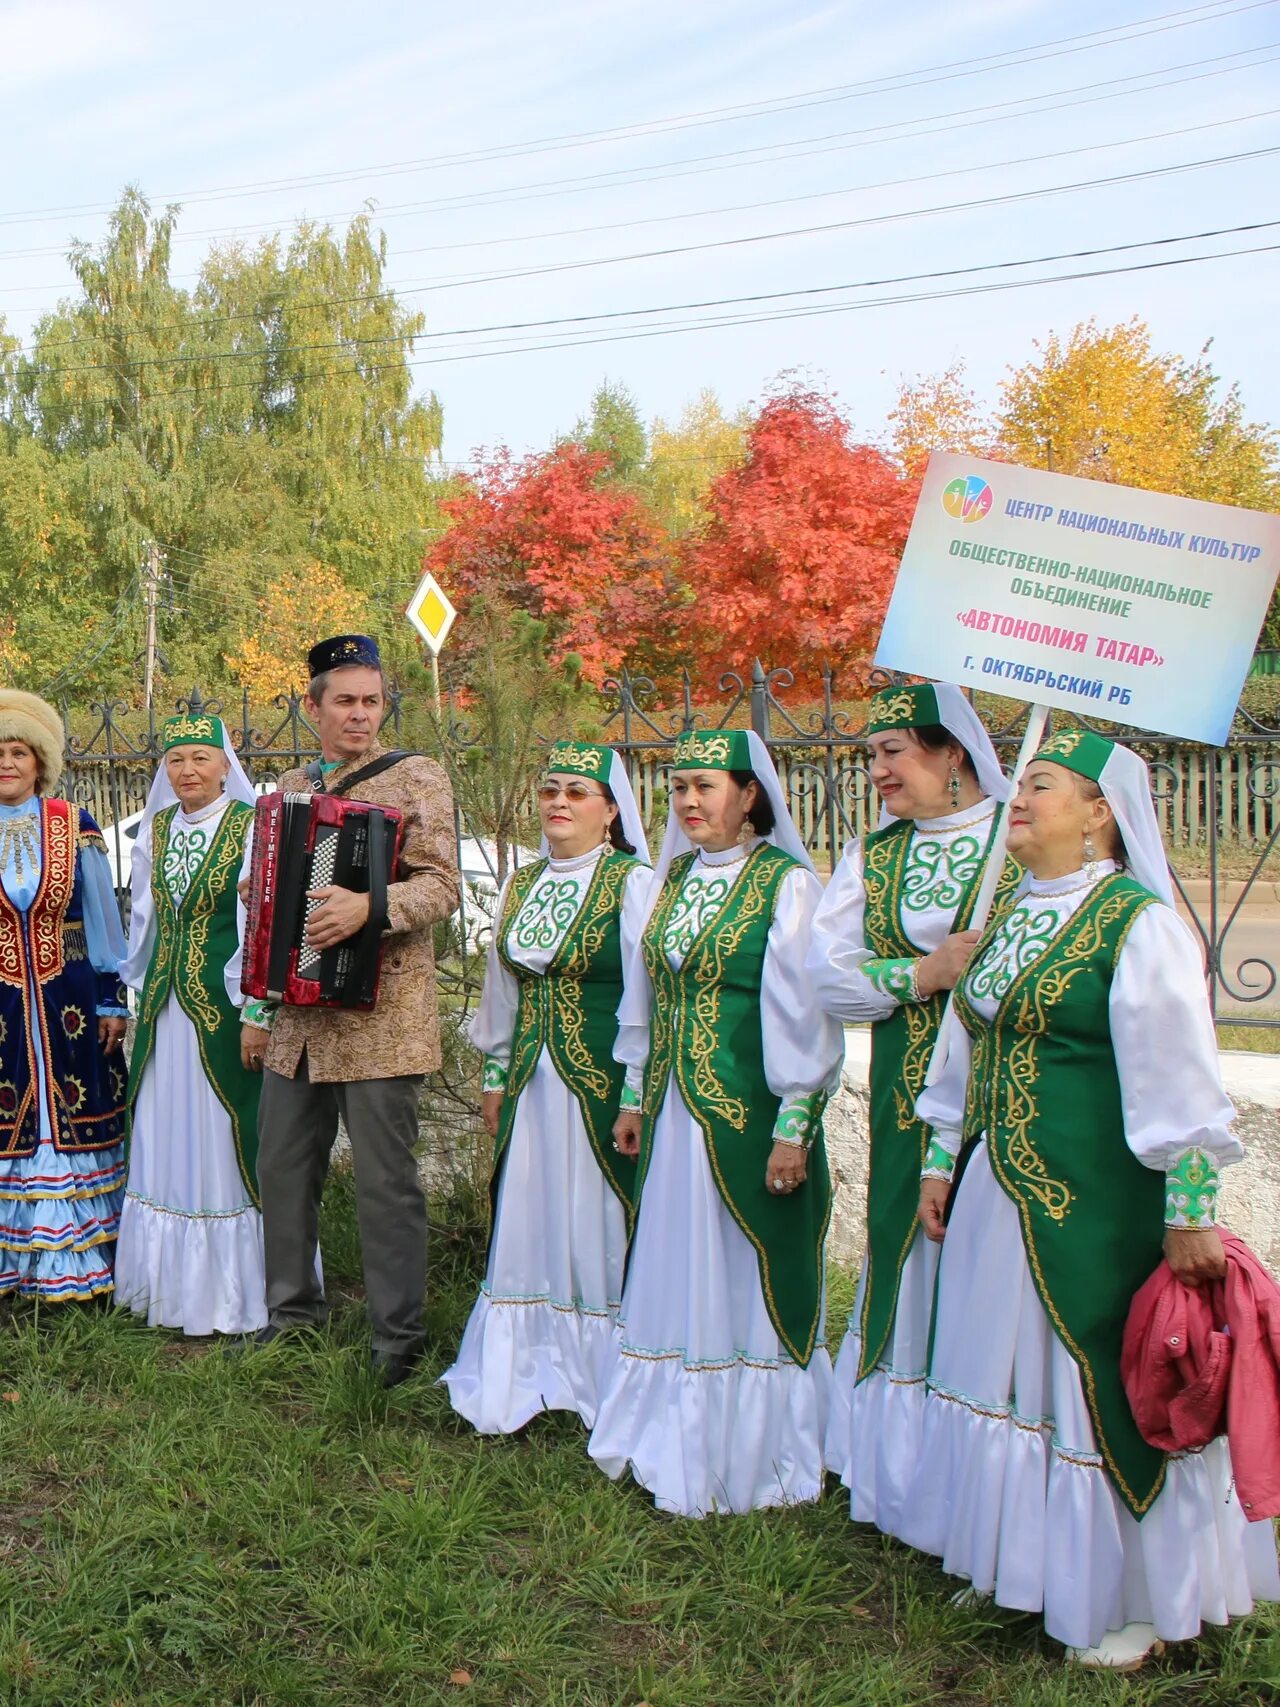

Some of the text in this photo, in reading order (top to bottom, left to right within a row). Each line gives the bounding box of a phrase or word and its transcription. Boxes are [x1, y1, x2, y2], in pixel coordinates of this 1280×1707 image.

[1004, 498, 1261, 563] ЦЕНТР НАЦИОНАЛЬНЫХ КУЛЬТУР
[948, 539, 1213, 608] ОБЩЕСТВЕННО-НАЦИОНАЛЬНОЕ
[1010, 578, 1132, 618] ОБЪЕДИНЕНИЕ
[956, 608, 1164, 667] «АВТОНОМИЯ ТАТАР»
[963, 655, 1132, 706] г. ОКТЯБРЬСКИЙ РБ
[264, 808, 278, 903] WELTMEISTER
